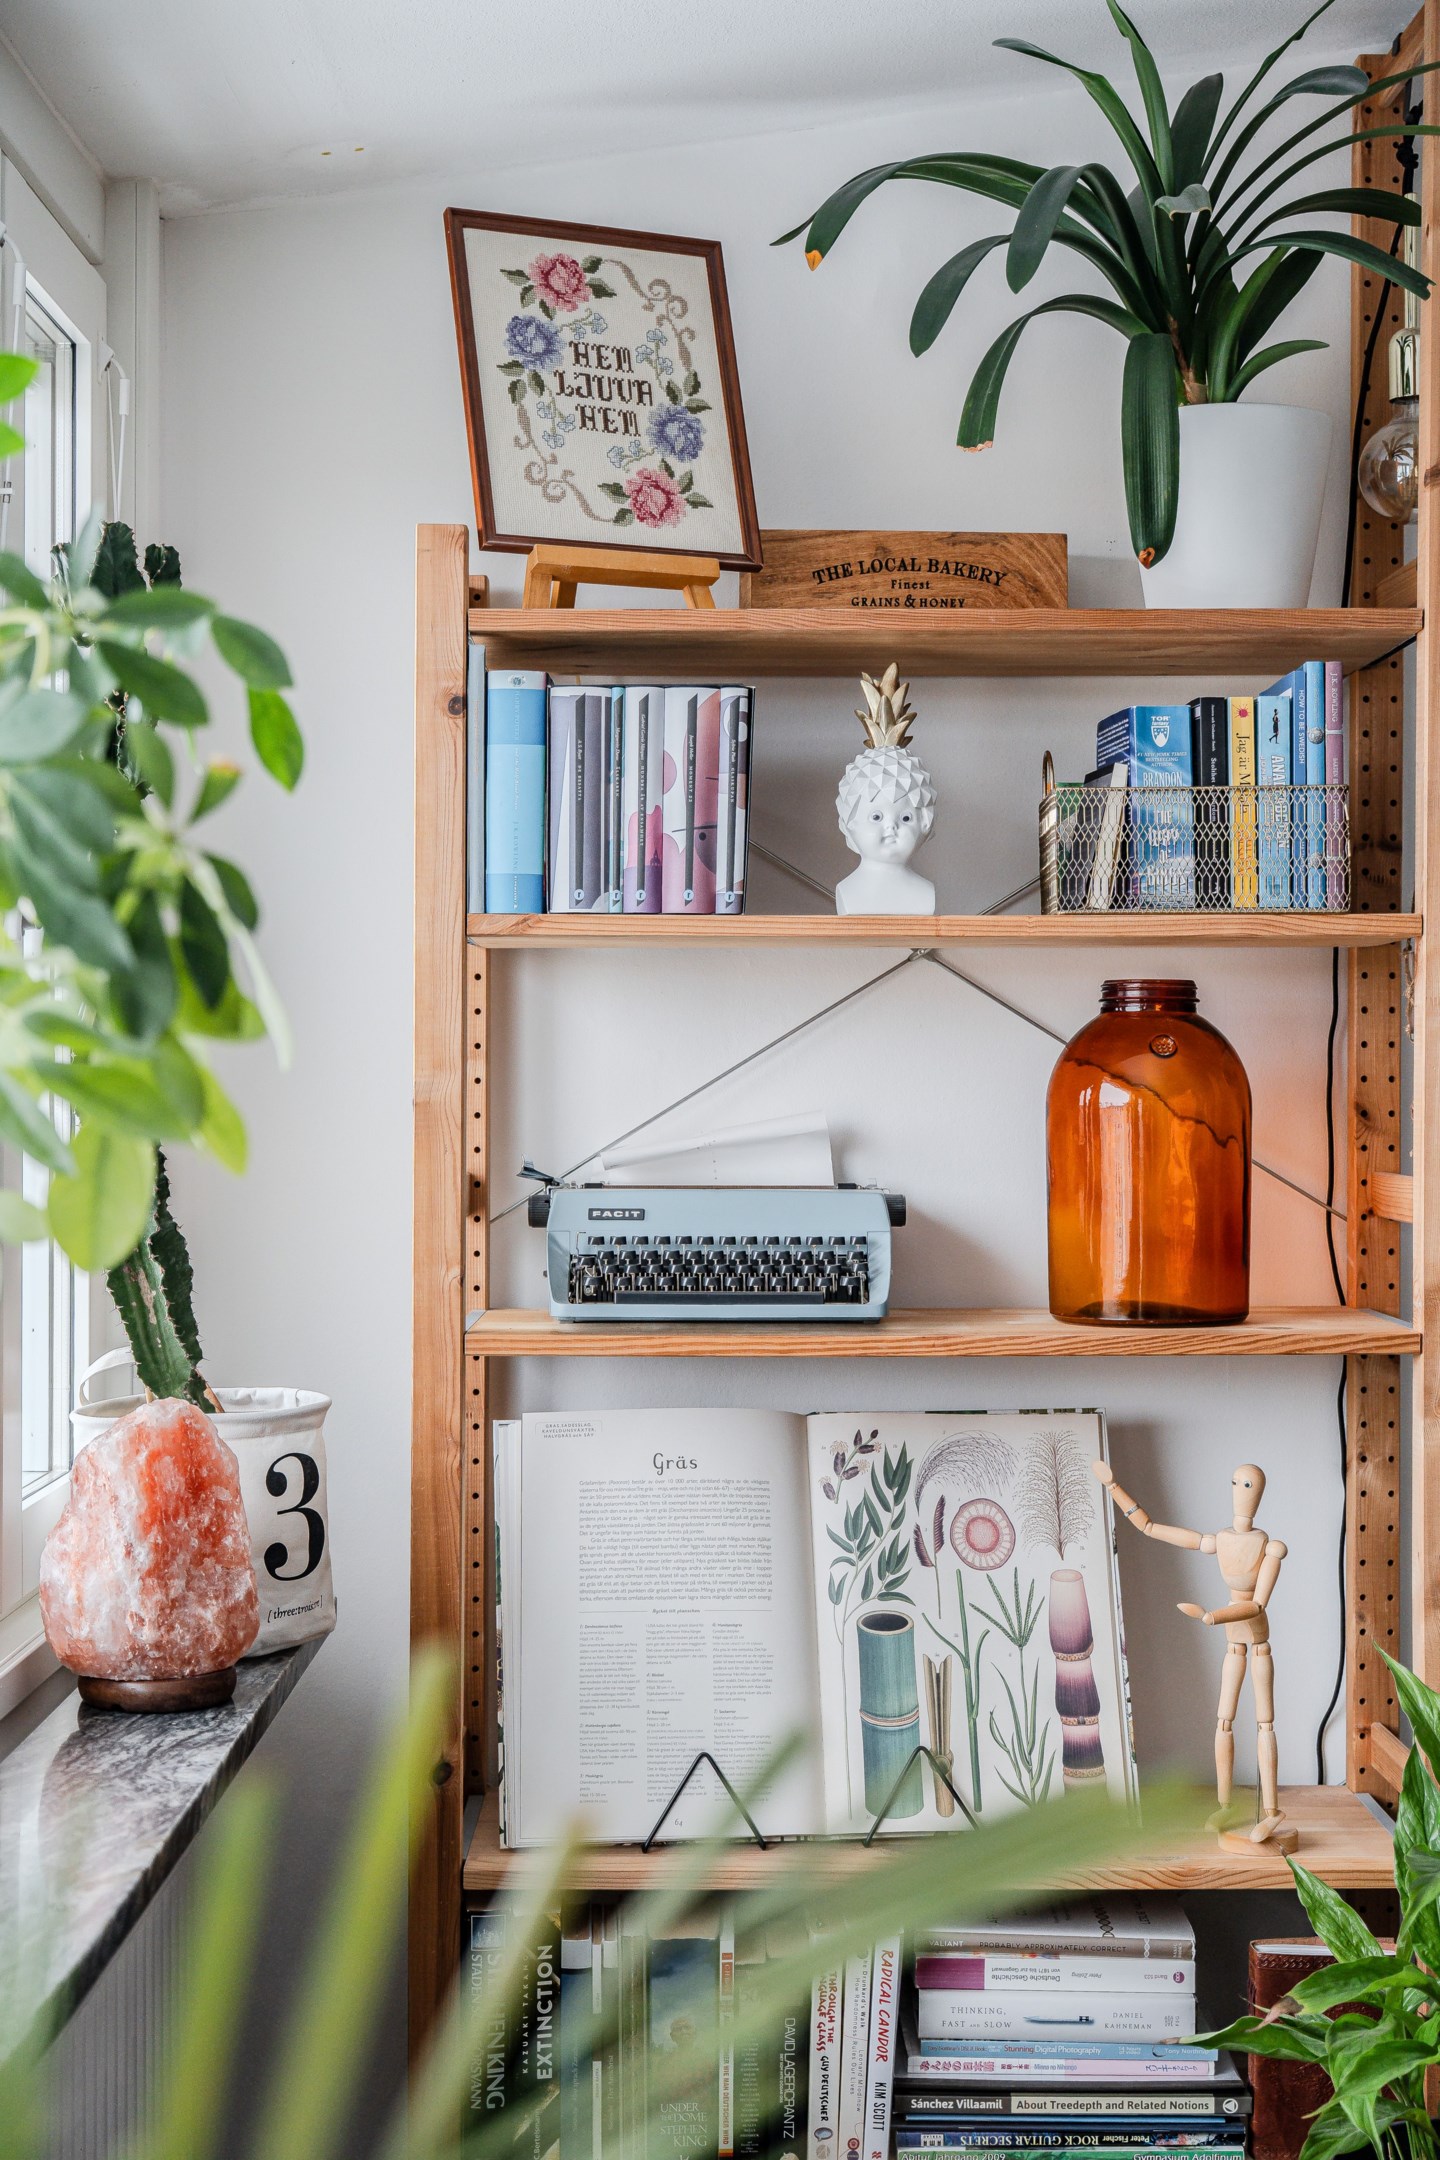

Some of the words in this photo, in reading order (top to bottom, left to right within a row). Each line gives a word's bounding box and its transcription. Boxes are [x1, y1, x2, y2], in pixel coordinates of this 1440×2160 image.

[568, 341, 634, 373] HEM
[553, 369, 653, 406] LJUVA
[575, 404, 641, 437] HEM
[812, 562, 853, 585] THE
[858, 557, 922, 575] LOCAL
[927, 558, 1007, 587] BAKERY
[890, 579, 930, 588] Finest
[851, 597, 900, 607] GRAINS
[904, 594, 916, 608] &
[919, 598, 966, 608] HONEY
[1298, 707, 1305, 718] TO
[1298, 720, 1305, 730] BE
[1236, 733, 1250, 753] Jag
[1239, 756, 1250, 770] är
[1143, 772, 1182, 787] BRANDON
[653, 1452, 698, 1476] Gräs
[263, 1452, 326, 1582] 3
[674, 1818, 683, 1827] 64
[1024, 1942, 1087, 1952] APPROXIMATELY
[471, 1954, 483, 2004] STADEN
[879, 1950, 894, 2005] RADICAL
[1030, 1974, 1060, 1982] Deutsche
[827, 1972, 838, 2023] THROUGH
[536, 1944, 553, 2079] EXTINCTION
[950, 2006, 1007, 2016] THINKING,
[784, 2018, 796, 2050] DAVID
[816, 2022, 826, 2052] GLASS
[875, 2009, 890, 2062] CANDOR
[1004, 2044, 1034, 2054] Stunning
[1034, 2044, 1056, 2055] Digital
[1057, 2045, 1102, 2055] Photography
[485, 2054, 504, 2109] KING
[783, 2052, 796, 2139] LAGERCRANTZ
[819, 2074, 829, 2121] DEUTSCHER
[875, 2082, 886, 2099] KIM
[661, 2102, 698, 2113] UNDER
[911, 2098, 954, 2110] Sánchez
[956, 2098, 1002, 2110] Villaamil
[1016, 2100, 1048, 2110] About
[1050, 2100, 1102, 2112] Treedepth
[1105, 2100, 1124, 2110] and
[1127, 2100, 1166, 2110] Related
[1169, 2100, 1209, 2110] Notions
[673, 2112, 707, 2122] DOME
[873, 2102, 885, 2131] SCOTT
[660, 2126, 707, 2135] STEPHEN
[674, 2136, 707, 2147] KING
[960, 2135, 1012, 2146] SECRETS
[1015, 2135, 1061, 2146] GUITAR
[1064, 2135, 1099, 2146] ROCK
[1130, 2135, 1150, 2143] Peter
